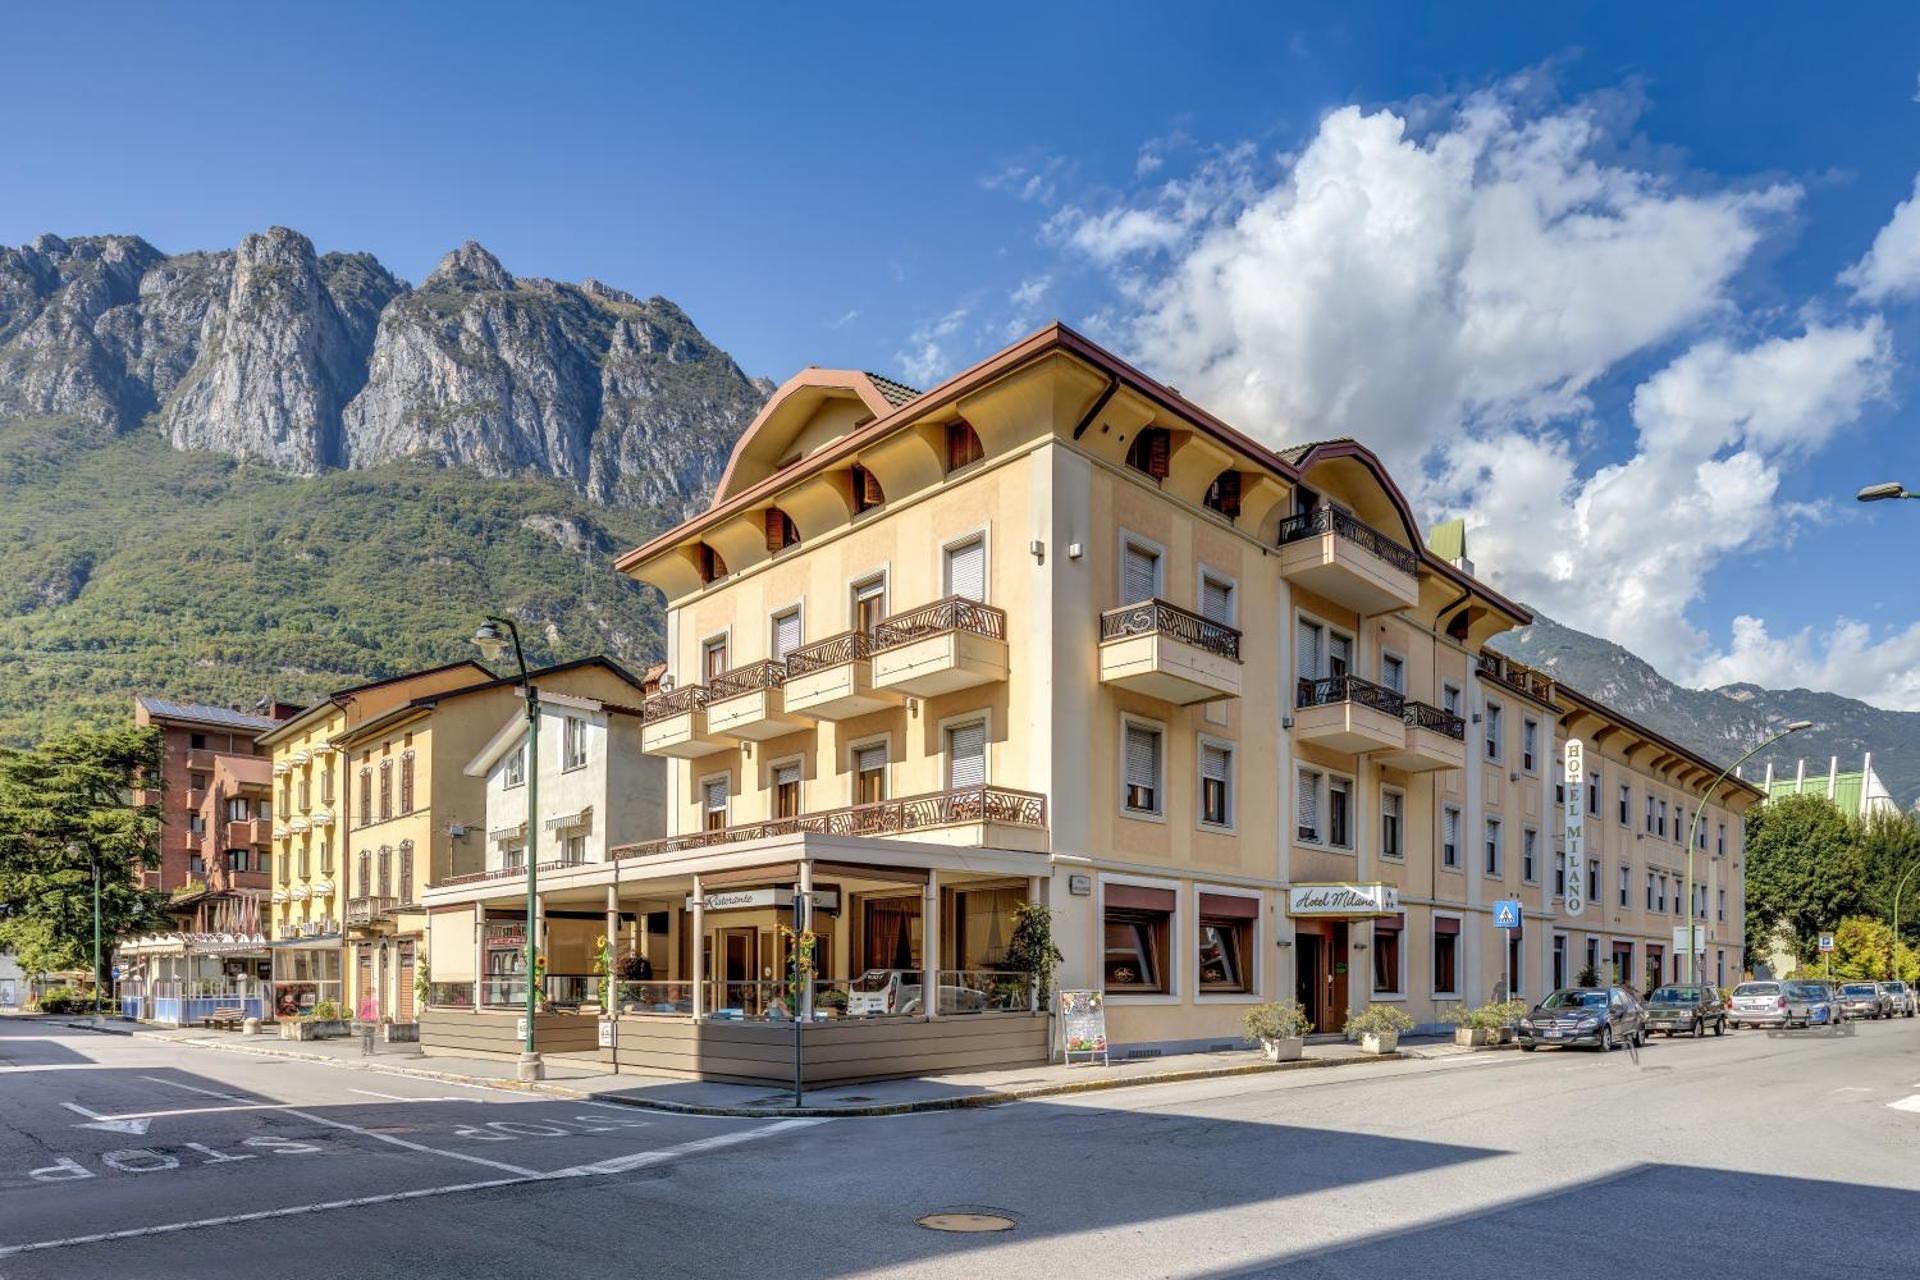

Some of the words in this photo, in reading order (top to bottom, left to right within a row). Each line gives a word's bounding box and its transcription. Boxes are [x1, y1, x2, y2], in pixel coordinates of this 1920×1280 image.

[1567, 744, 1580, 817] HOTEL
[1567, 825, 1581, 911] MILANO
[704, 893, 754, 909] Ristorante
[1296, 889, 1329, 908] Hotel
[1330, 890, 1376, 908] Milano
[455, 1115, 657, 1141] STOP
[29, 1136, 322, 1182] STOP
